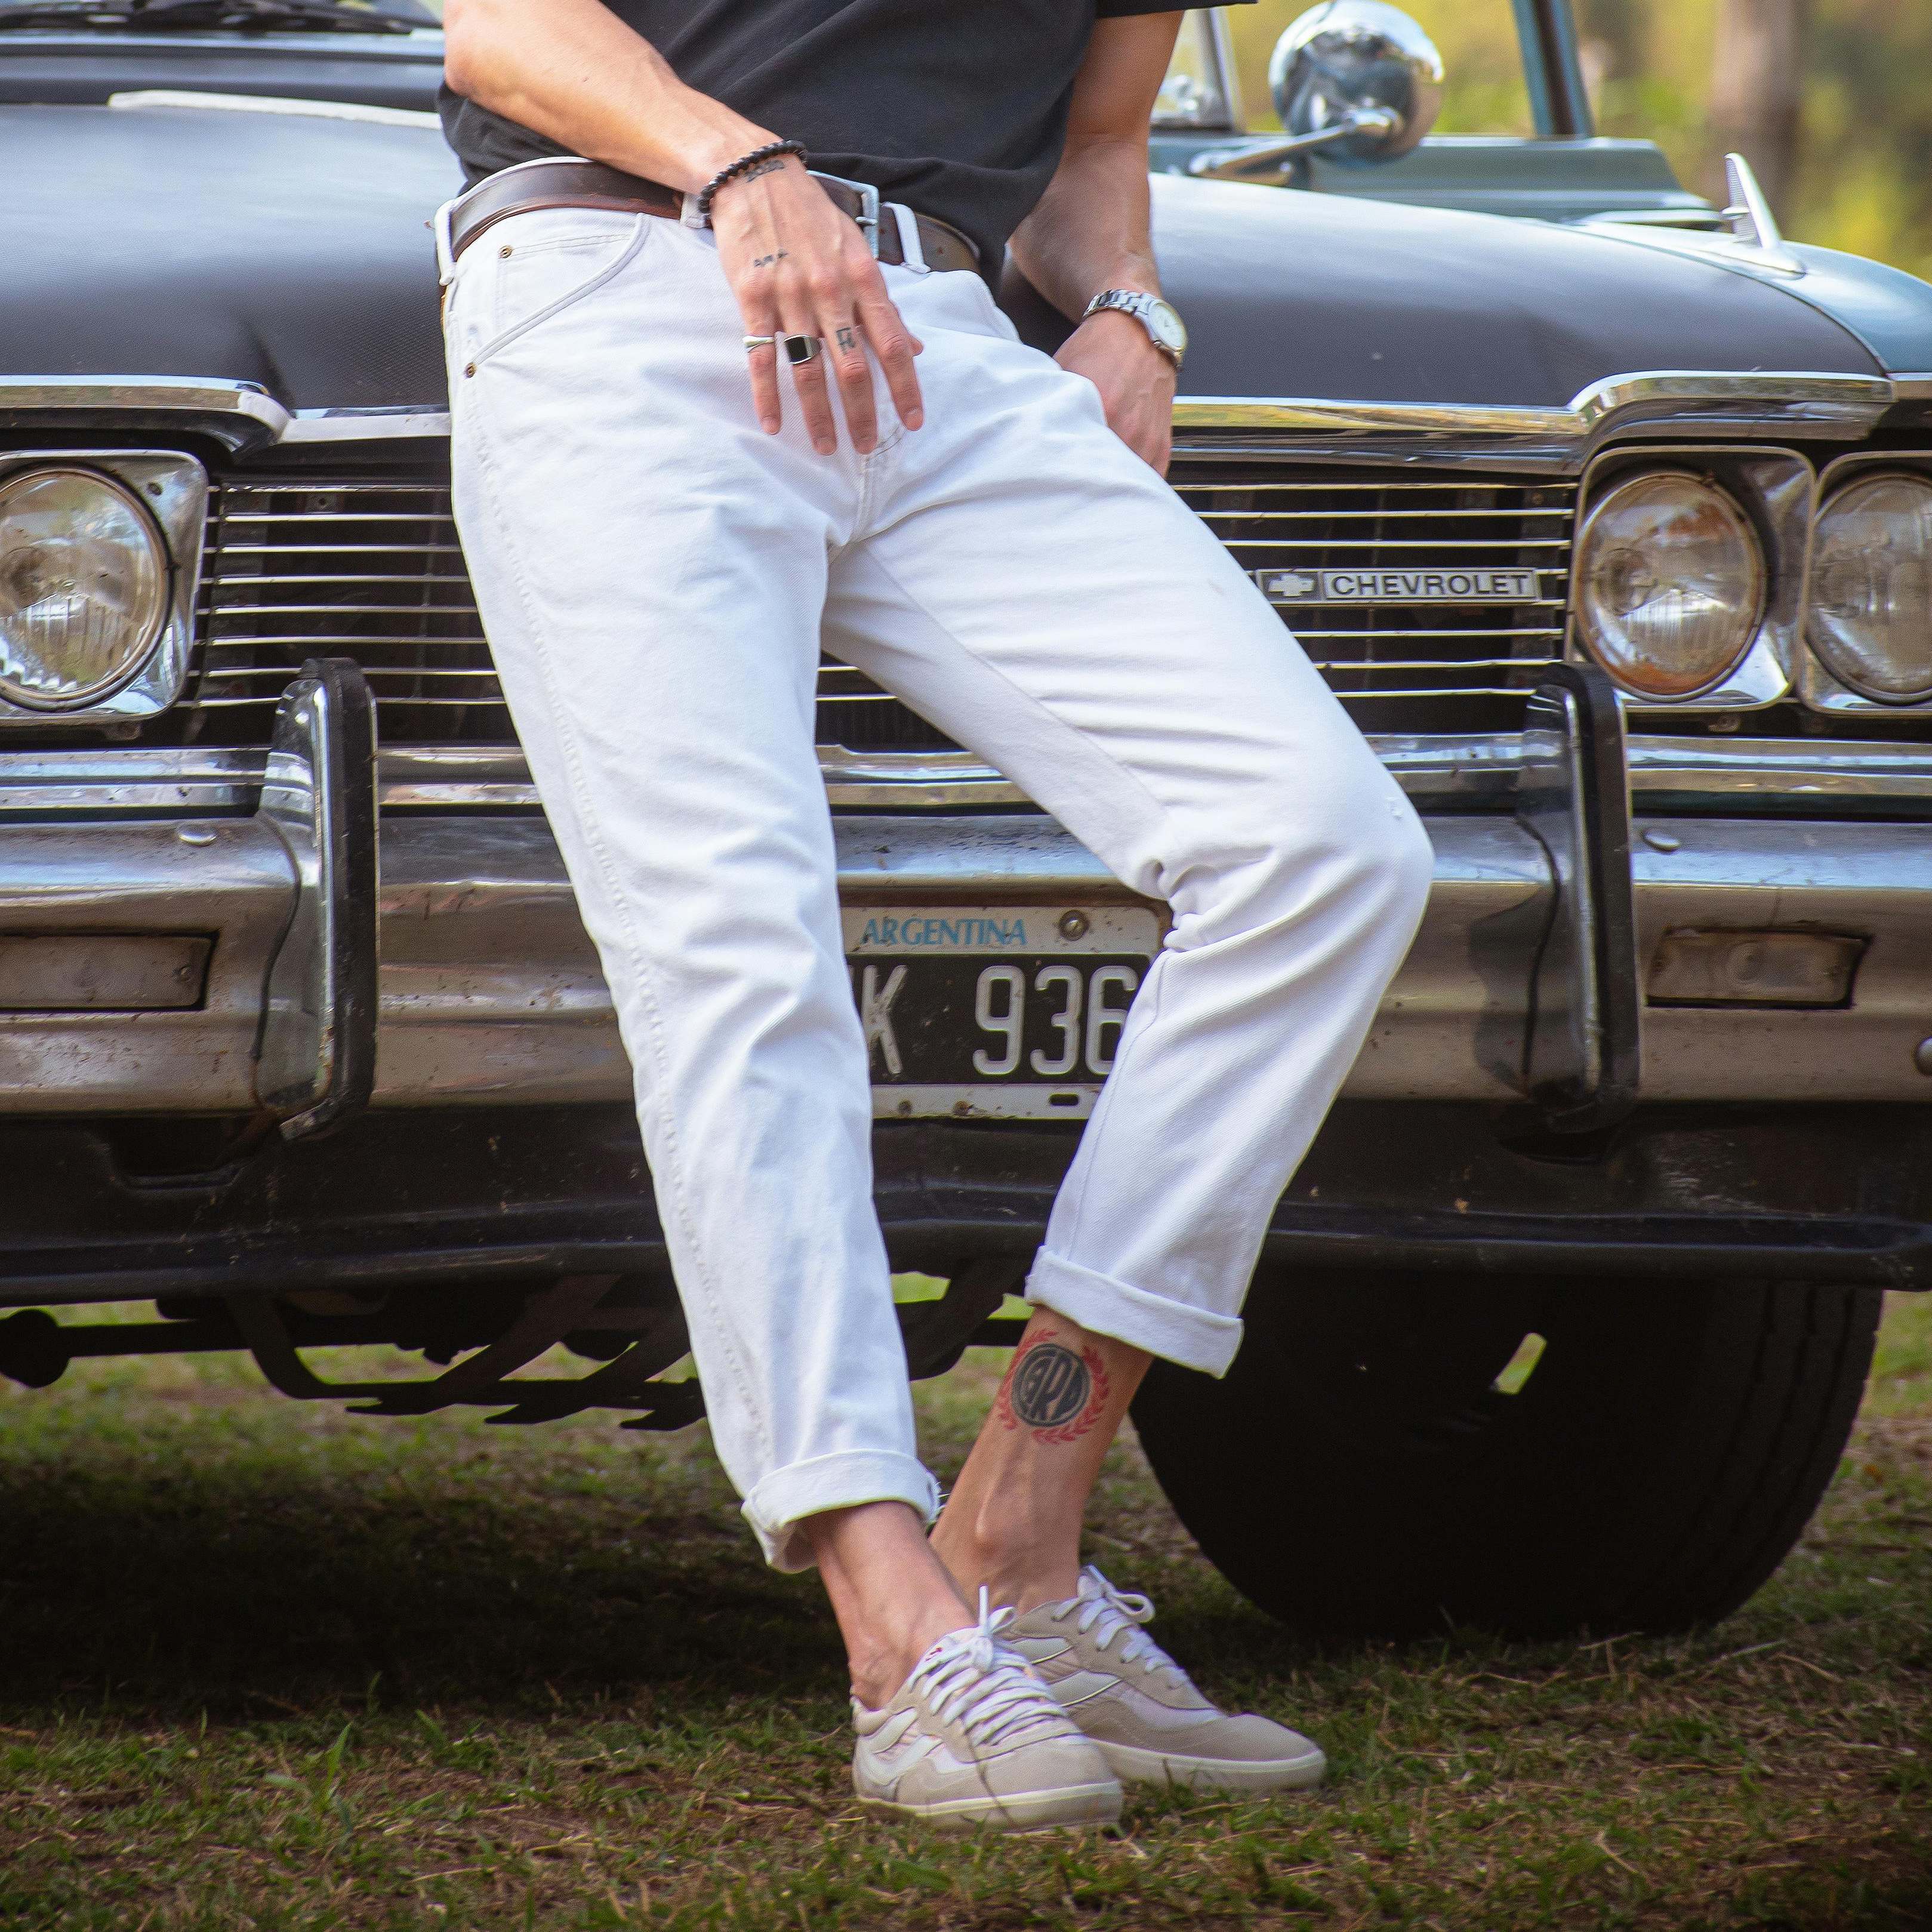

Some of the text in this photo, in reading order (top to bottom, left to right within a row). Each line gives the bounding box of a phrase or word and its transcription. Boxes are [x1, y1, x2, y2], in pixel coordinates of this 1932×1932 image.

[1332, 574, 1529, 595] CHEVROLET
[860, 917, 1028, 945] ARGENTINA
[850, 965, 1138, 1075] K 936
